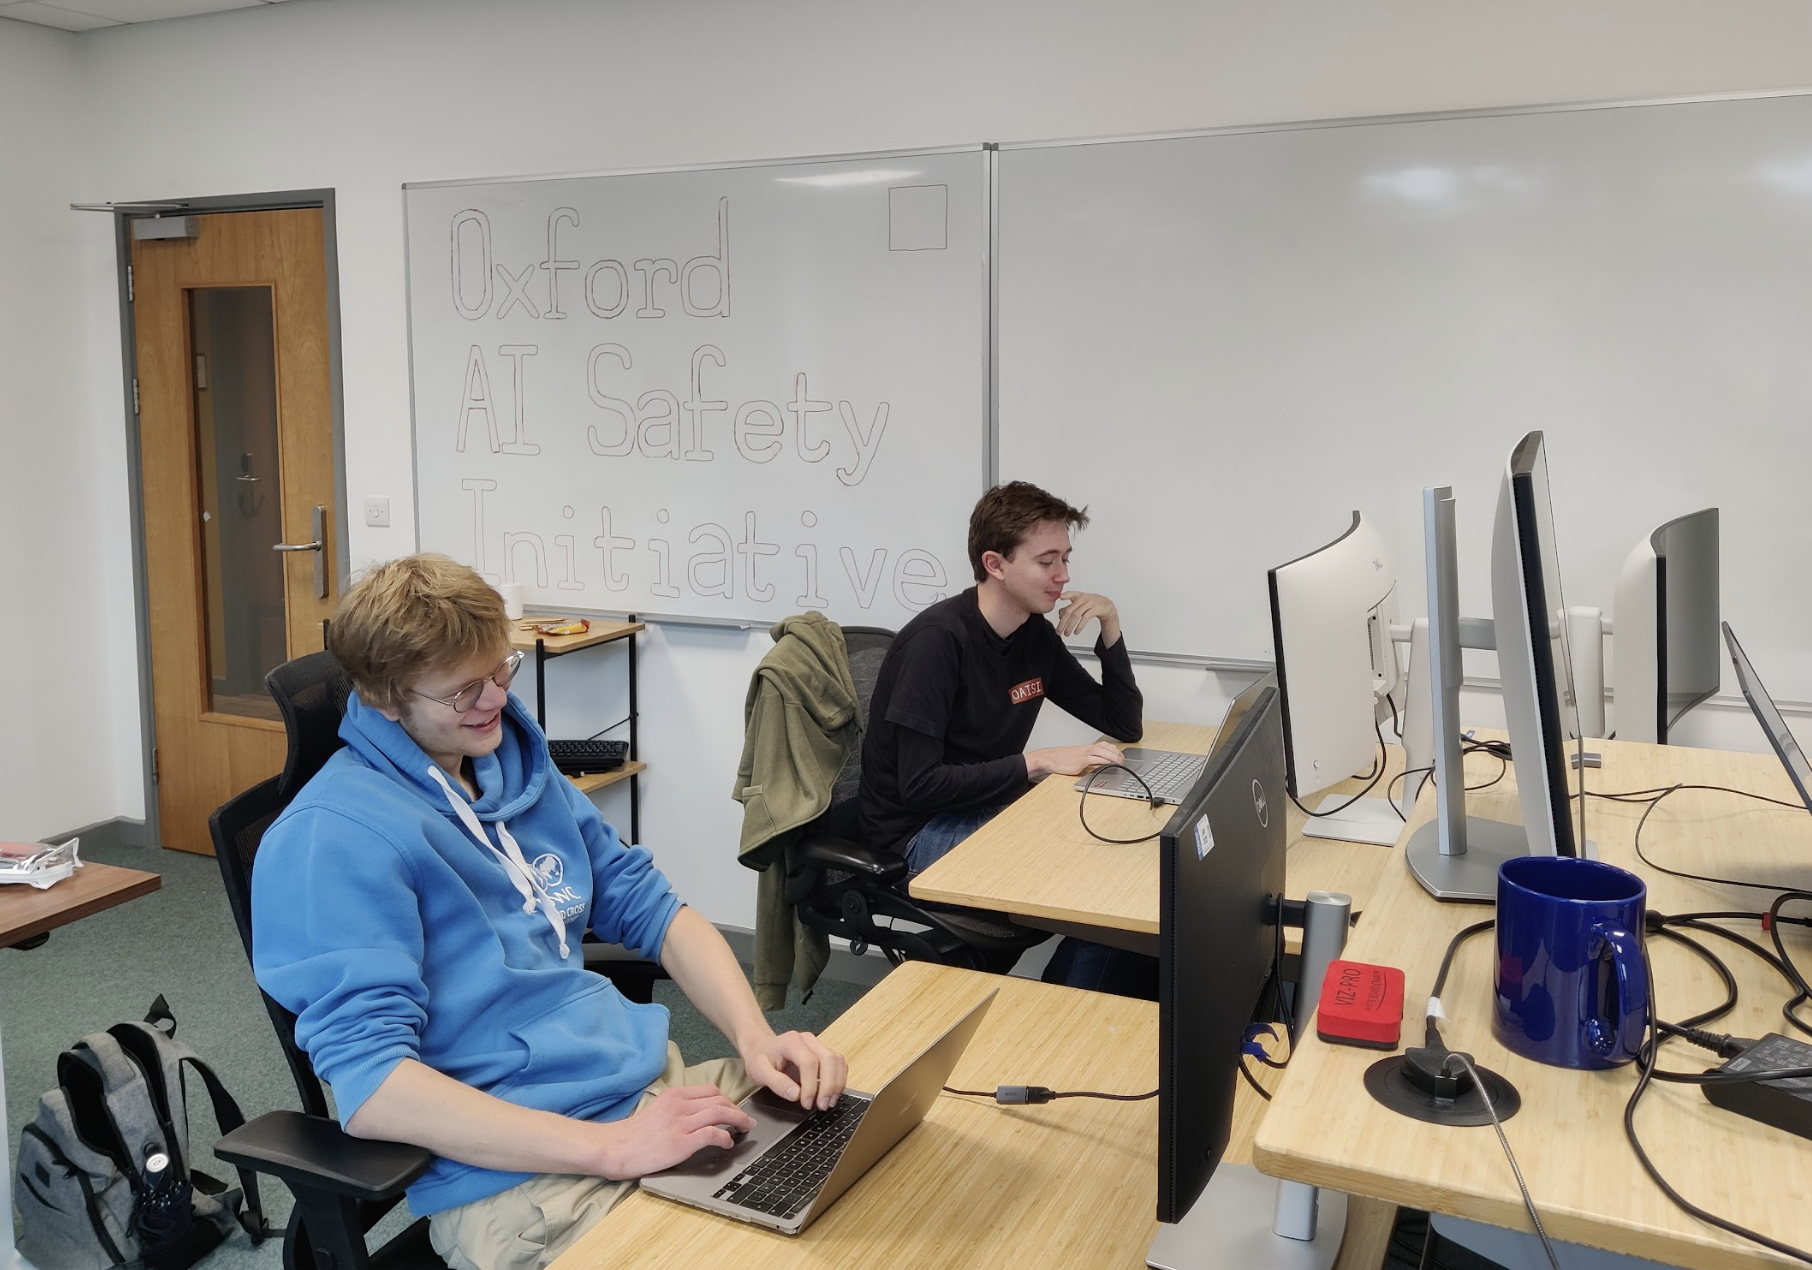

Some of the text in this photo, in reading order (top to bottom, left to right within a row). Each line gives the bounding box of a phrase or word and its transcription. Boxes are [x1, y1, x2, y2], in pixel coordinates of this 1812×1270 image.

[450, 196, 731, 320] Oxford
[456, 342, 890, 487] AI Safety
[461, 478, 948, 613] Initiative
[1011, 681, 1042, 700] OAISI
[1333, 968, 1361, 1006] VIZ-PRO
